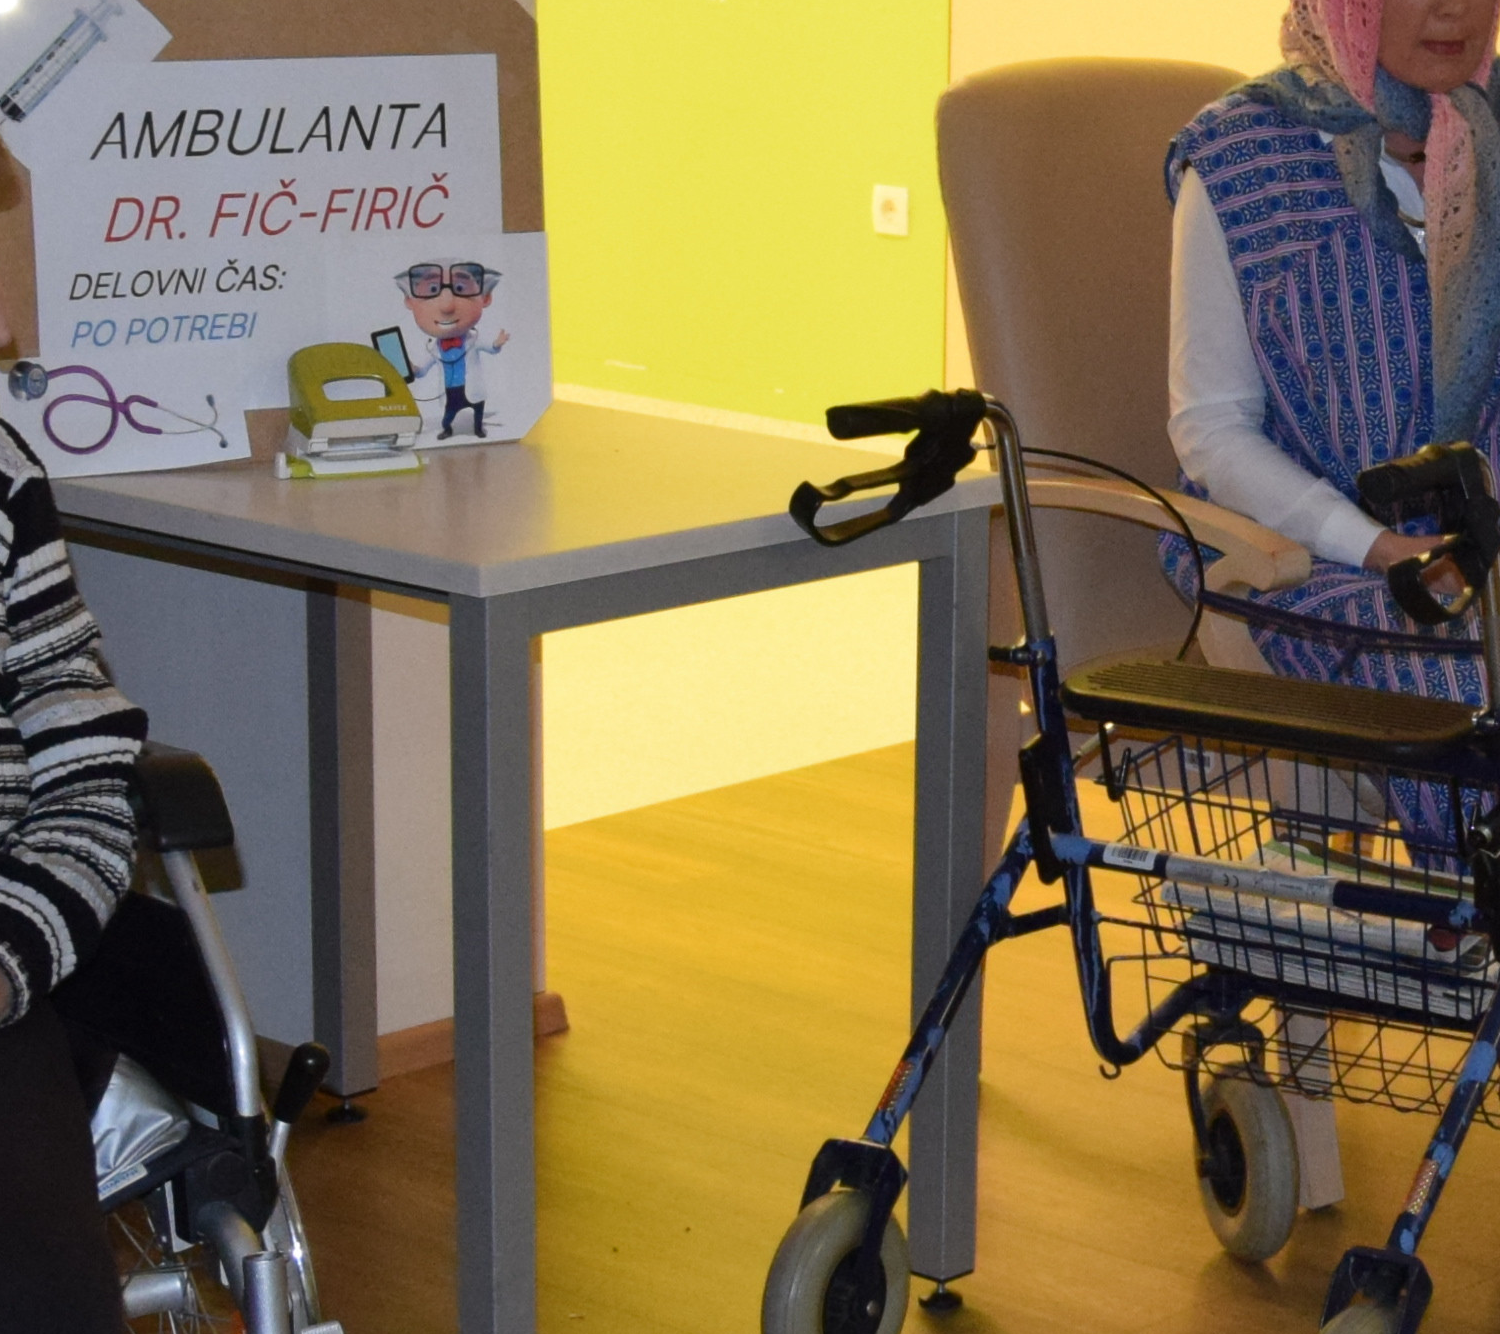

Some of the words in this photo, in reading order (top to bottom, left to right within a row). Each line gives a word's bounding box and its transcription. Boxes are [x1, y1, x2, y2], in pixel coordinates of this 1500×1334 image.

[90, 102, 448, 160] AMBULANTA
[104, 194, 187, 243] DR.
[208, 172, 450, 238] FIČ-FIRIČ
[69, 267, 207, 301] DELOVNI
[215, 259, 287, 293] ČAS:
[71, 319, 117, 348] PO
[125, 312, 258, 345] POTREBI
